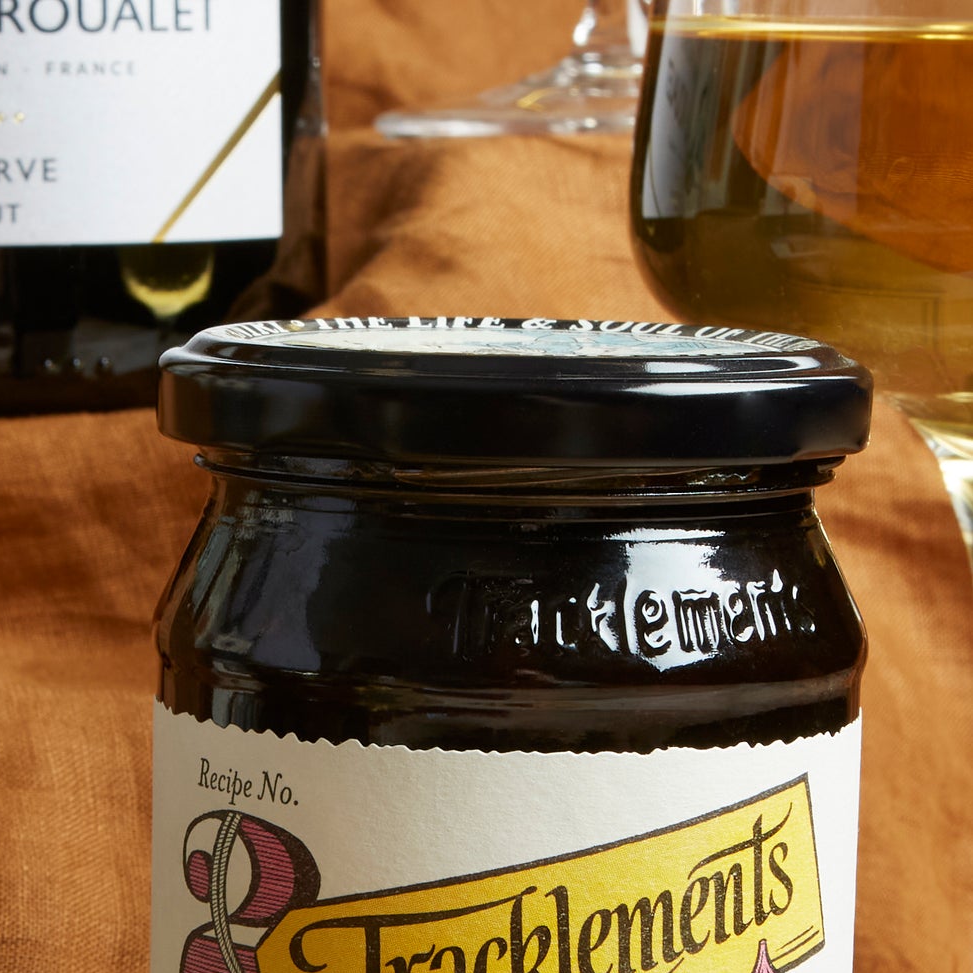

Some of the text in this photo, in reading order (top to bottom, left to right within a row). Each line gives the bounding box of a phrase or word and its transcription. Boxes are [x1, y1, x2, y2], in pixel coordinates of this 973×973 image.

[44, 60, 137, 78] FRANCE
[197, 757, 299, 807] Recipe No.
